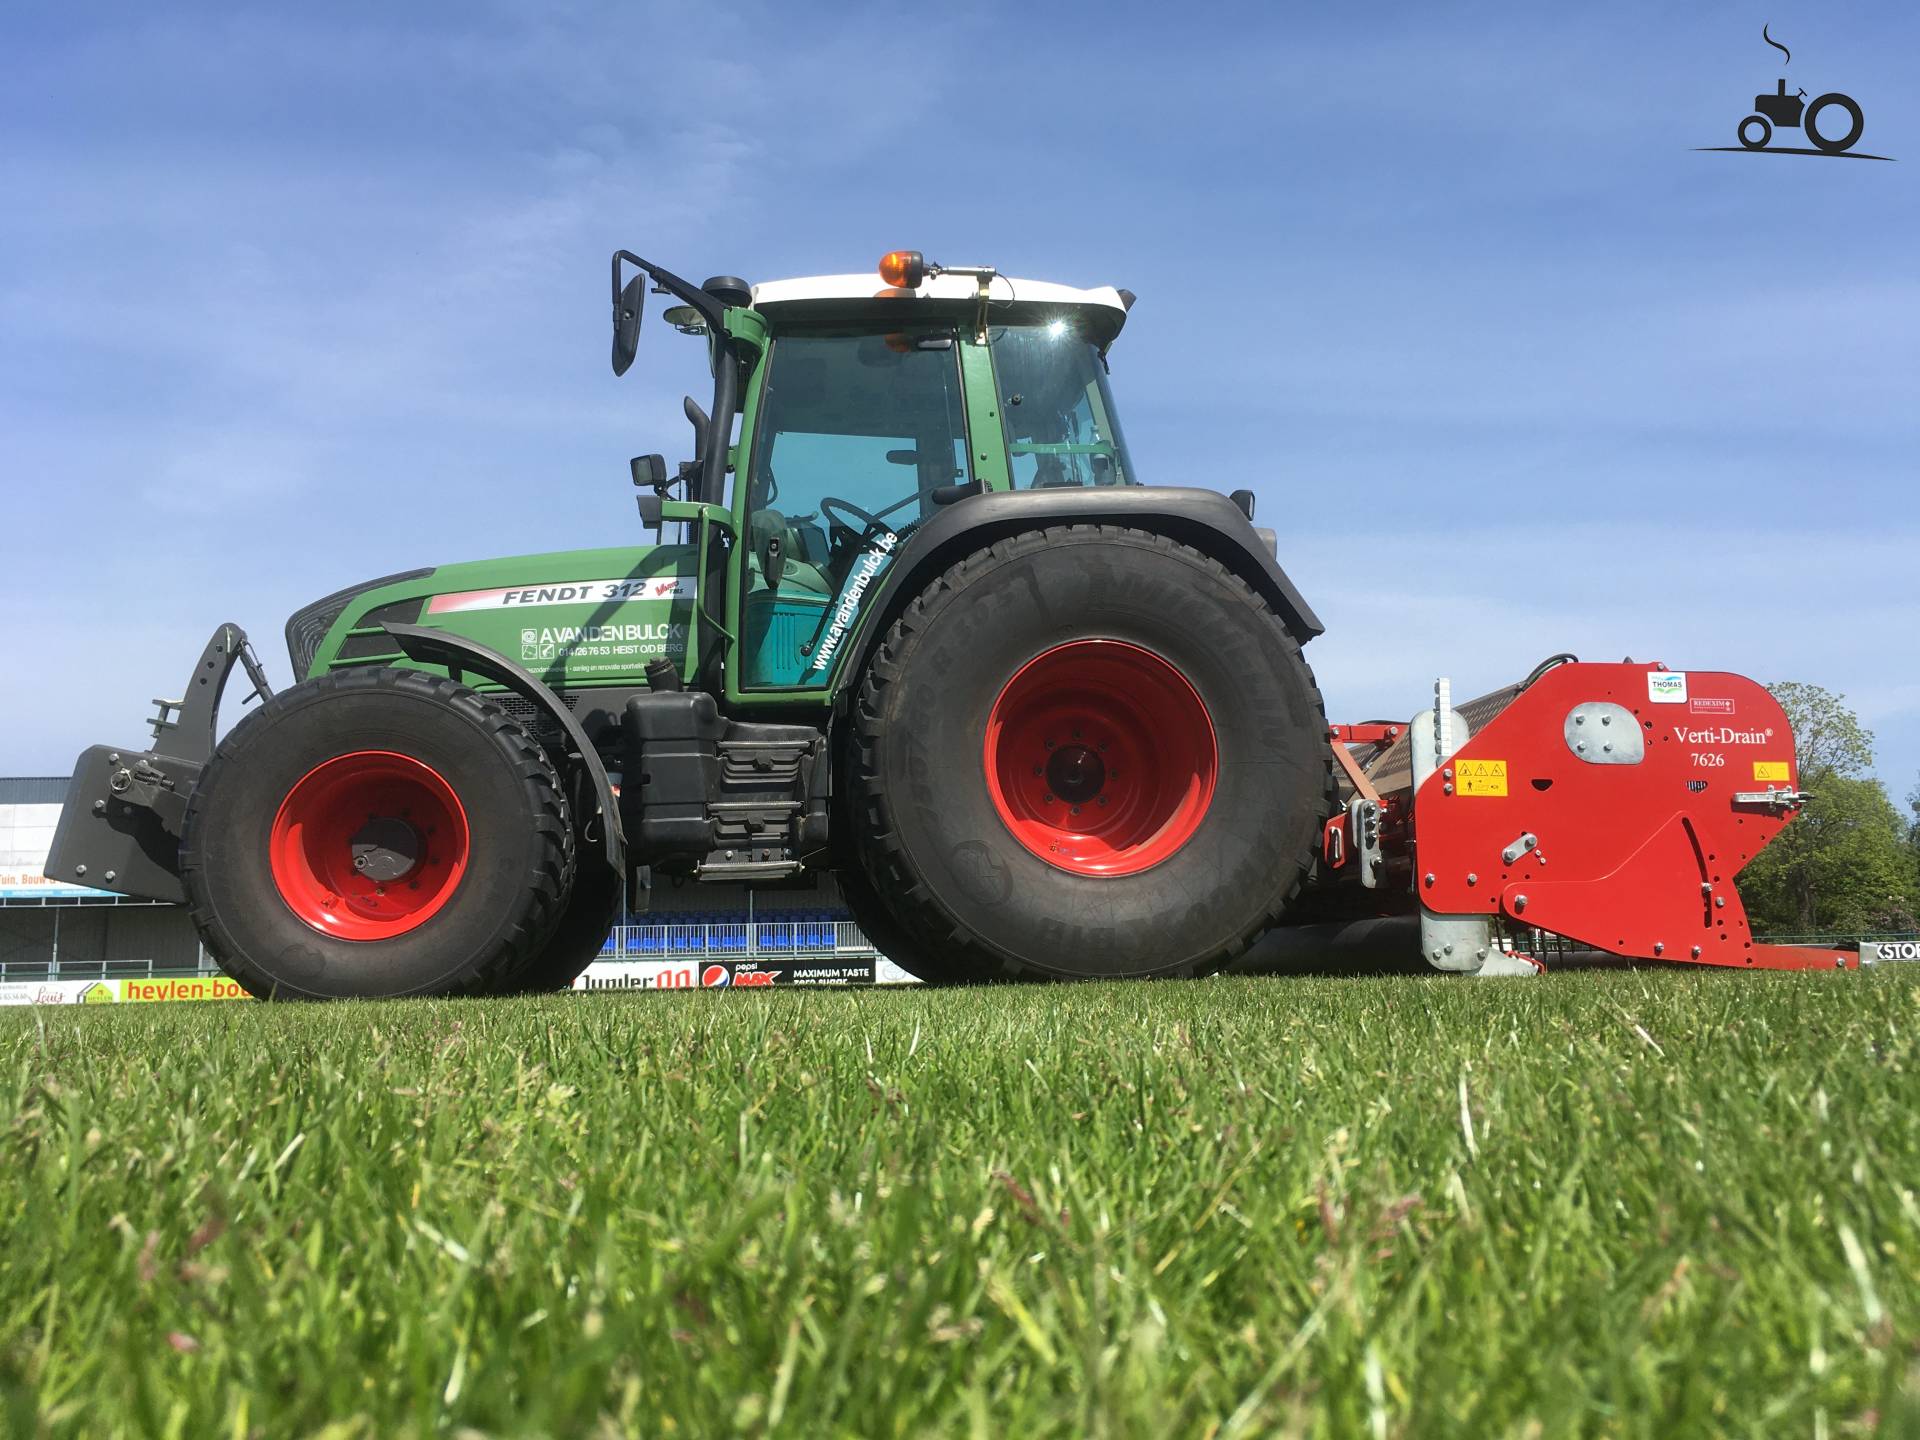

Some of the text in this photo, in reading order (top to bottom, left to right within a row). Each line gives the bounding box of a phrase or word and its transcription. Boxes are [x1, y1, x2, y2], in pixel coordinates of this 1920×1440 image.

[502, 581, 646, 605] FENDT 312
[812, 531, 899, 671] www.avandenbulck.be
[613, 645, 639, 655] HEIST
[657, 643, 684, 653] BERG
[1651, 680, 1683, 689] THOMAS
[1690, 752, 1725, 767] 7626
[22, 874, 46, 885] Bouw
[735, 962, 758, 972] pepsi
[793, 968, 870, 978] MAXIMUM TASTE
[732, 970, 783, 986] MAX
[35, 984, 65, 1004] Louis
